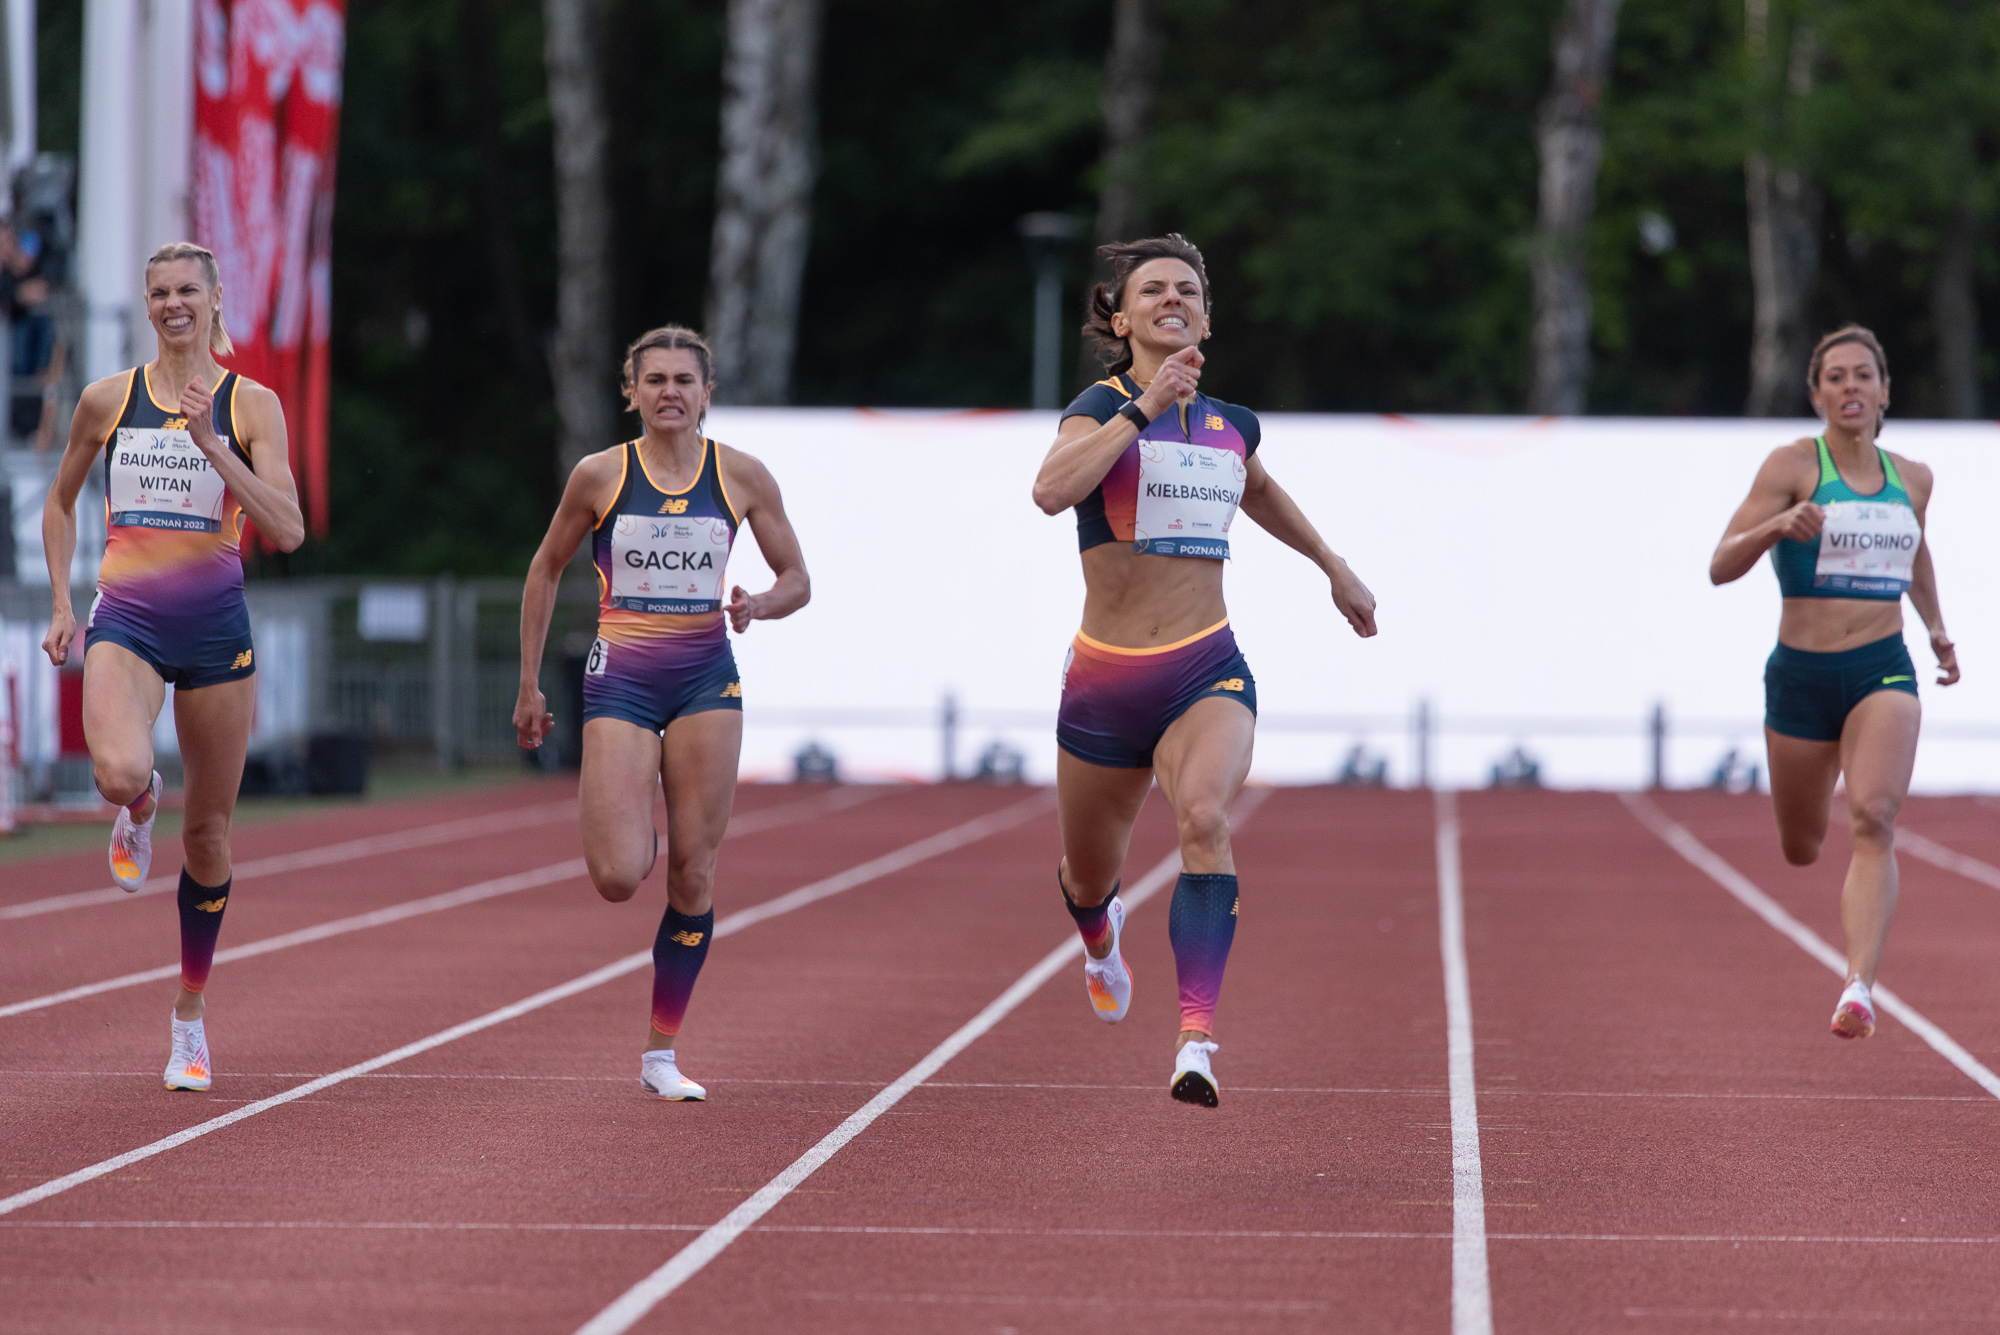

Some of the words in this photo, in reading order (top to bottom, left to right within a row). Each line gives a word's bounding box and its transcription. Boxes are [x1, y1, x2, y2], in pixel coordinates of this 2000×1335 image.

[139, 476, 192, 493] WITAN
[1146, 483, 1239, 506] KIEŁBASIŃSKA
[143, 516, 181, 528] POZNAŃ
[183, 520, 205, 529] 2022
[1180, 544, 1222, 556] POZNAŃ
[1830, 533, 1913, 551] VITORINO
[625, 550, 713, 571] GACKA
[648, 603, 687, 613] POZNAŃ
[690, 604, 709, 613] 2022
